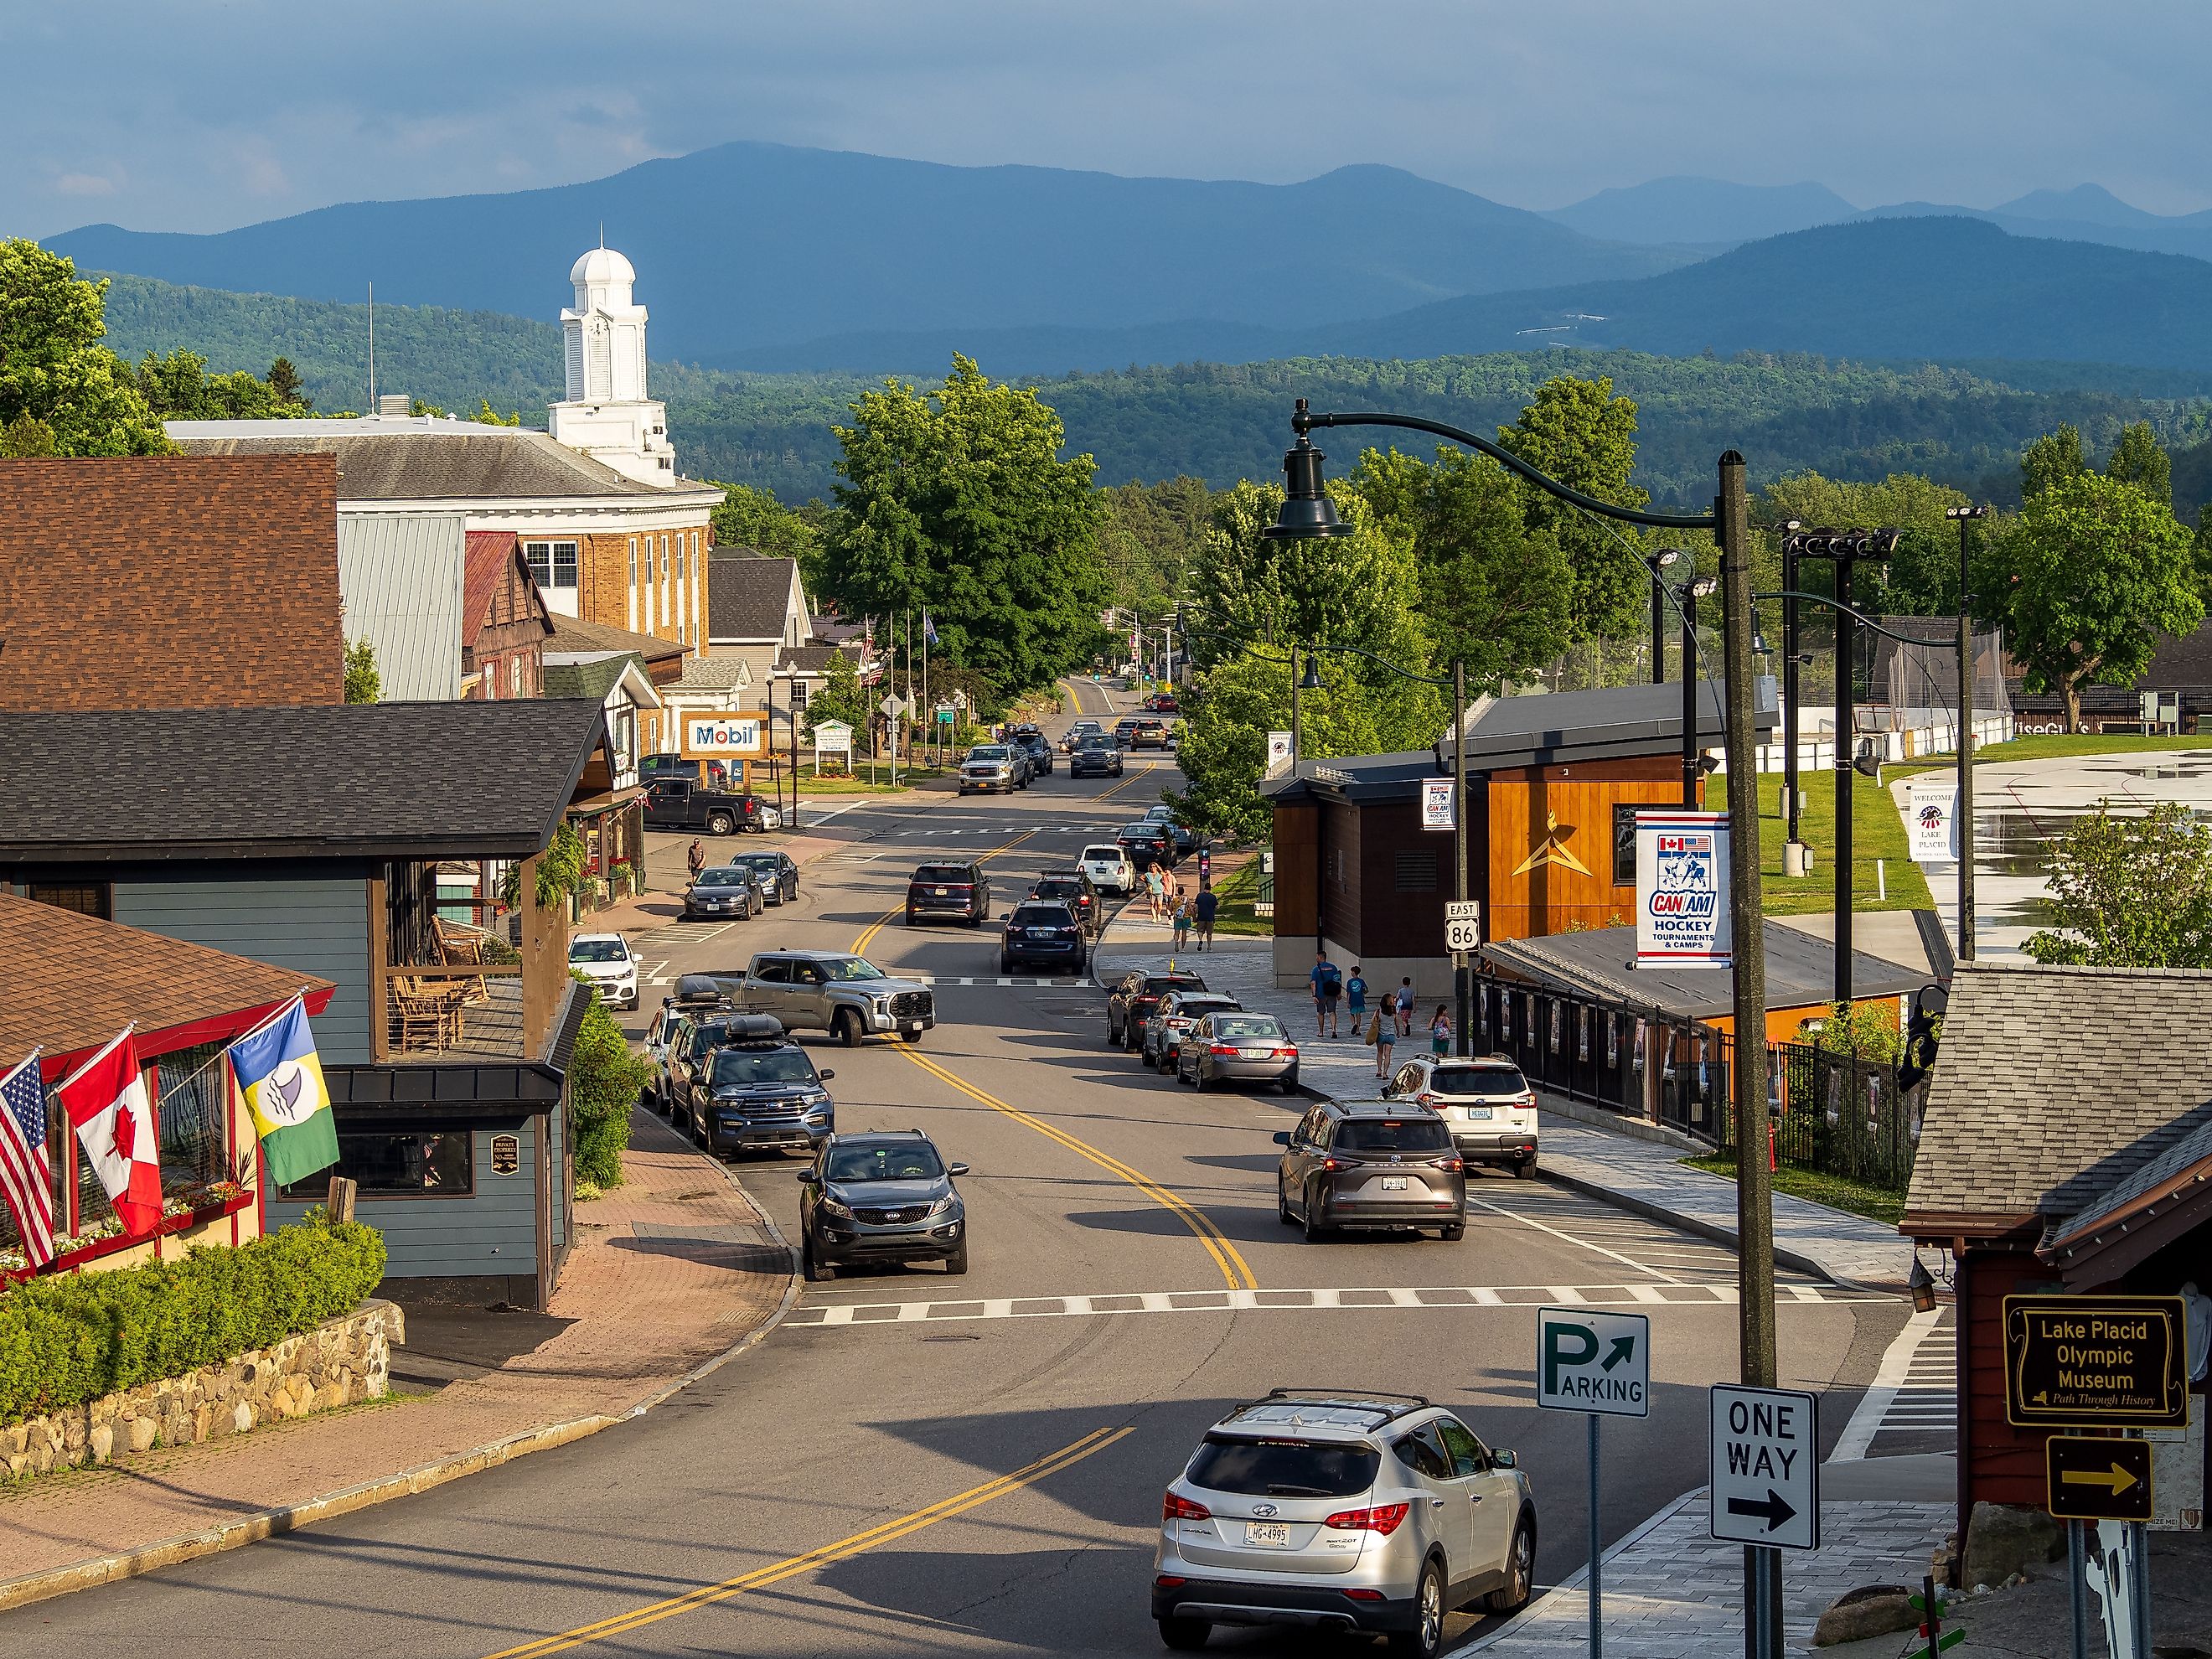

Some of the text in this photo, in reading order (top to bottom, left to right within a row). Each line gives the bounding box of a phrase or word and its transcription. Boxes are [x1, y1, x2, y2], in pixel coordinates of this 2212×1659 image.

[696, 726, 752, 744] Mobil
[1450, 904, 1474, 915] EAST
[1452, 927, 1473, 943] 86
[1655, 921, 1712, 931] HOCKEY
[2042, 1320, 2147, 1341] Lake Placid
[1544, 1321, 1642, 1403] PARKING
[2057, 1346, 2134, 1367] Olympic
[2059, 1370, 2134, 1389] Museum
[2053, 1393, 2156, 1408] Path Through History
[1729, 1400, 1796, 1440] ONE
[1726, 1441, 1799, 1481] WAY
